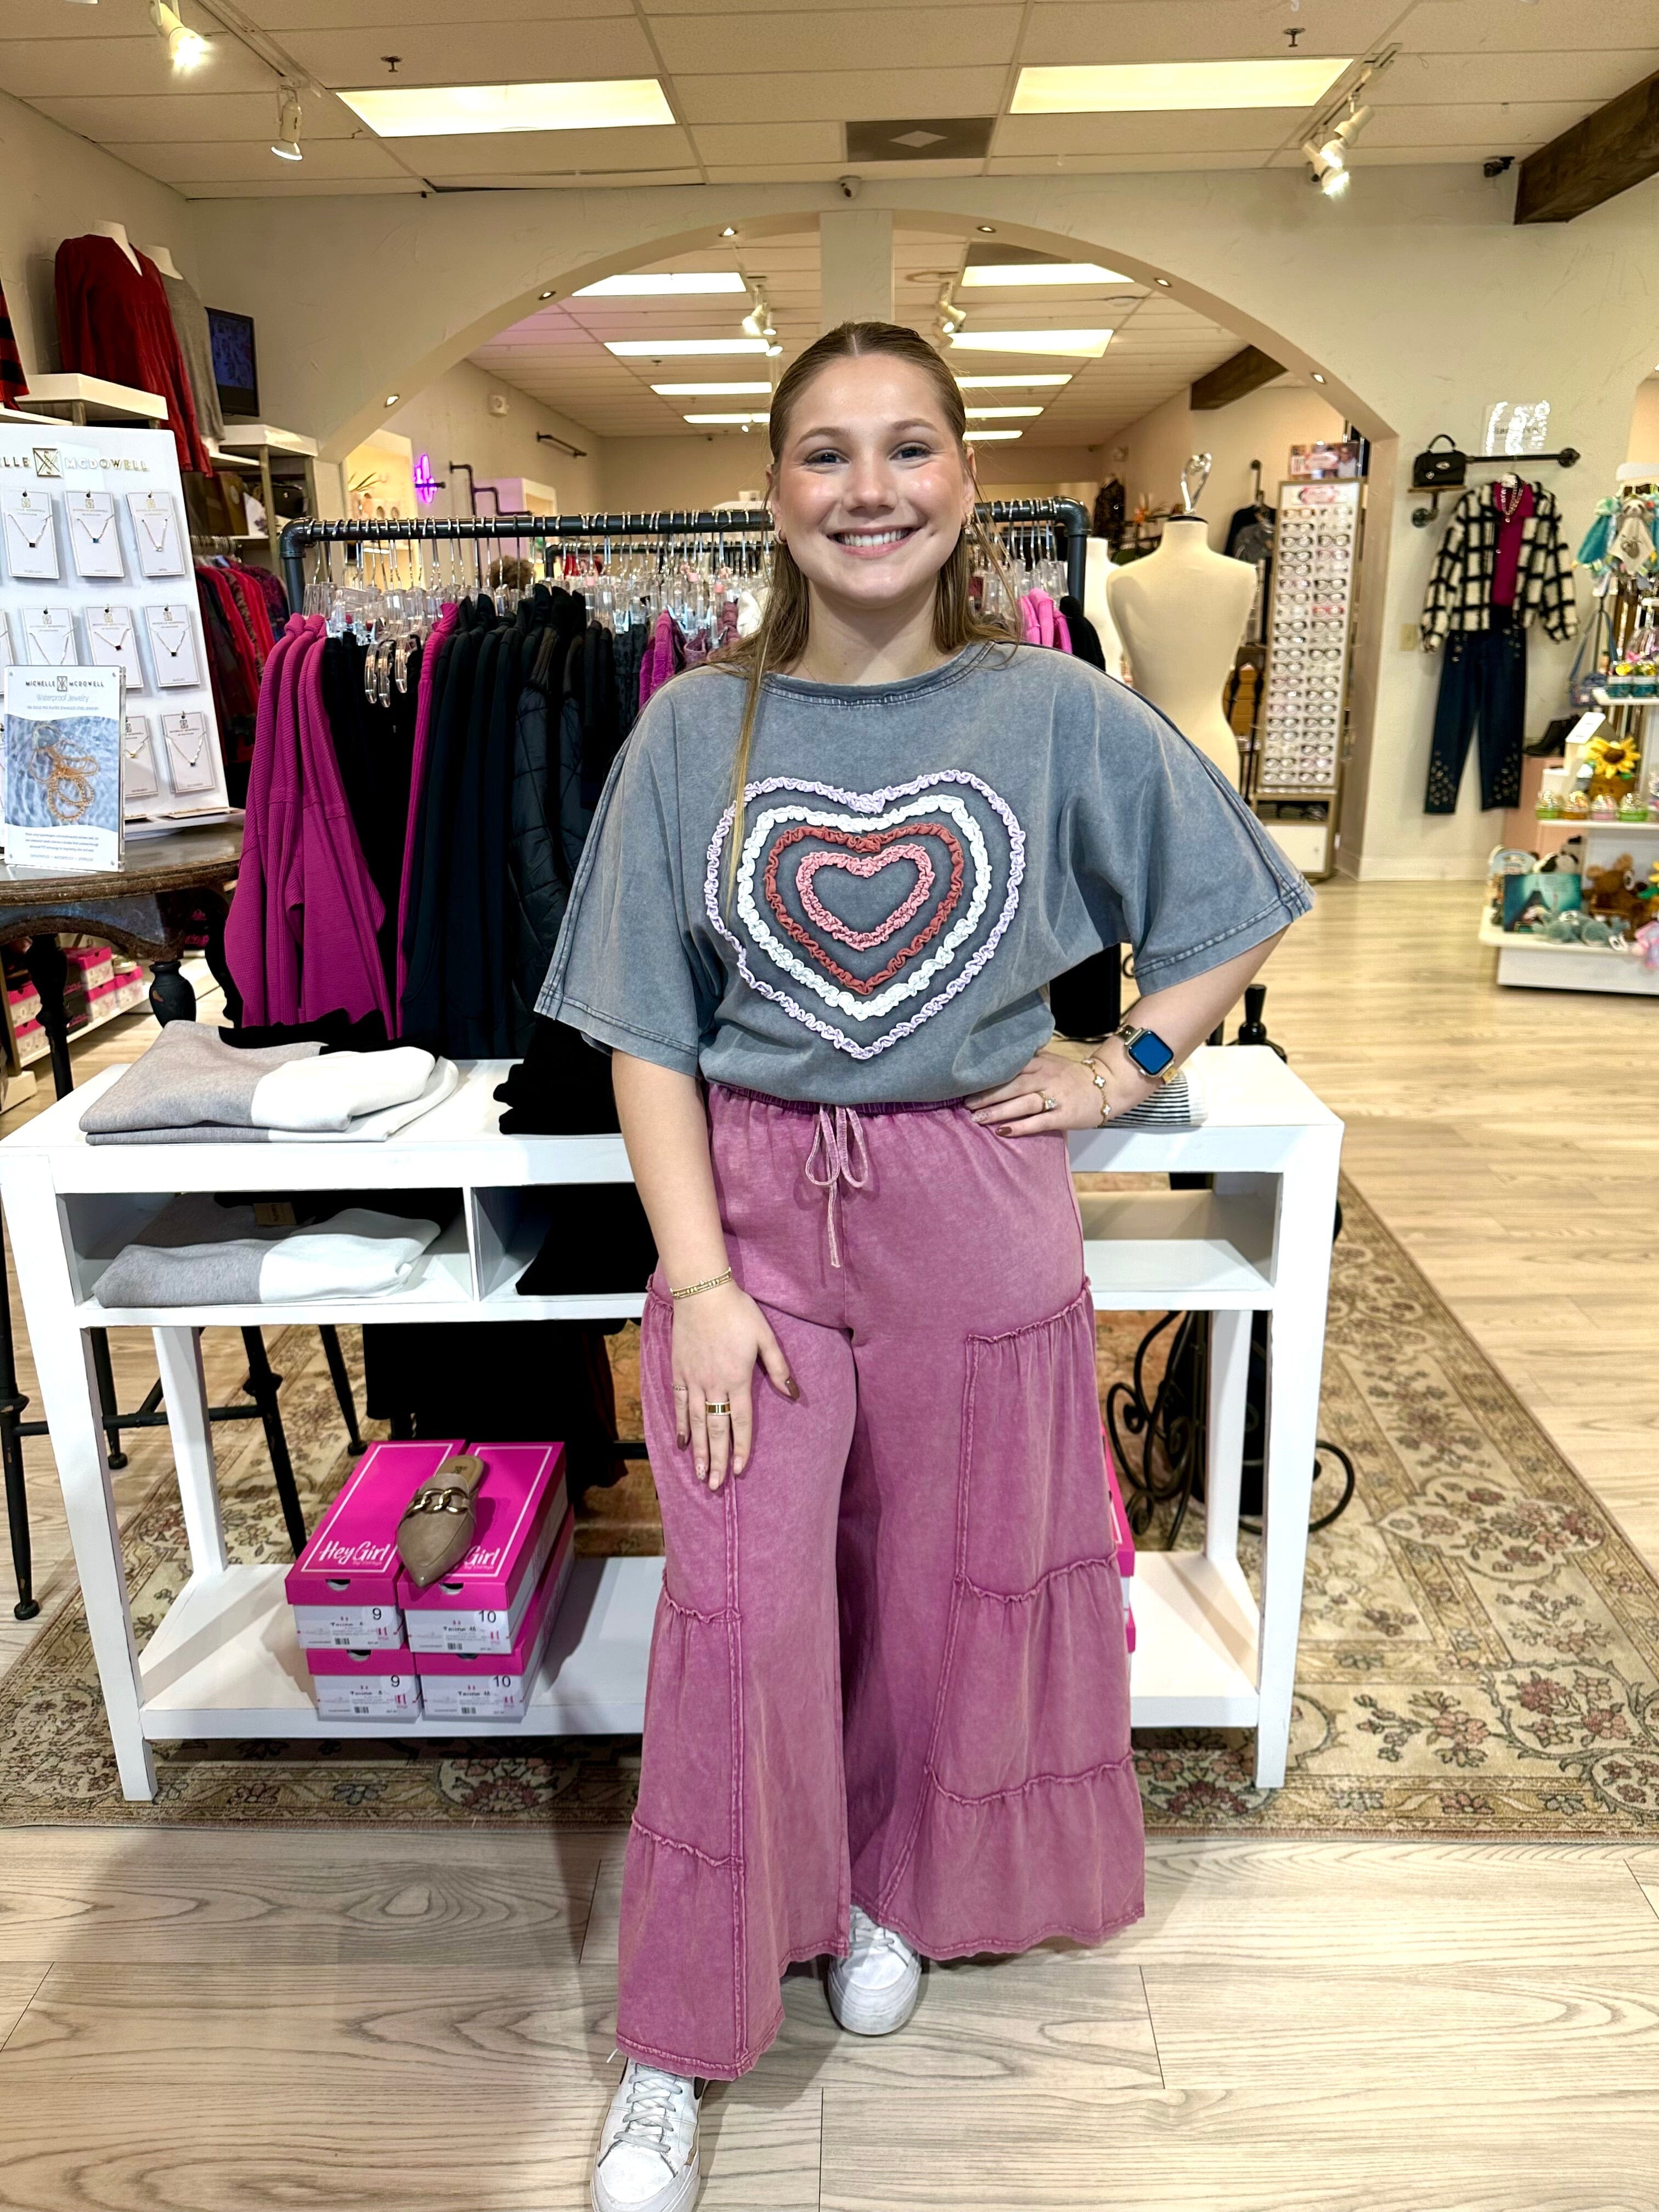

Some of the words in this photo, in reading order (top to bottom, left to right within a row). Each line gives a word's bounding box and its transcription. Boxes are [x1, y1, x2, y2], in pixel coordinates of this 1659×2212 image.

[64, 458, 149, 472] MCDOWELL
[36, 693, 67, 702] Waterproof
[68, 694, 89, 703] Jewelry
[372, 1607, 382, 1620] 9
[478, 1610, 496, 1623] 10
[390, 1675, 400, 1687] 9
[493, 1675, 511, 1688] 10
